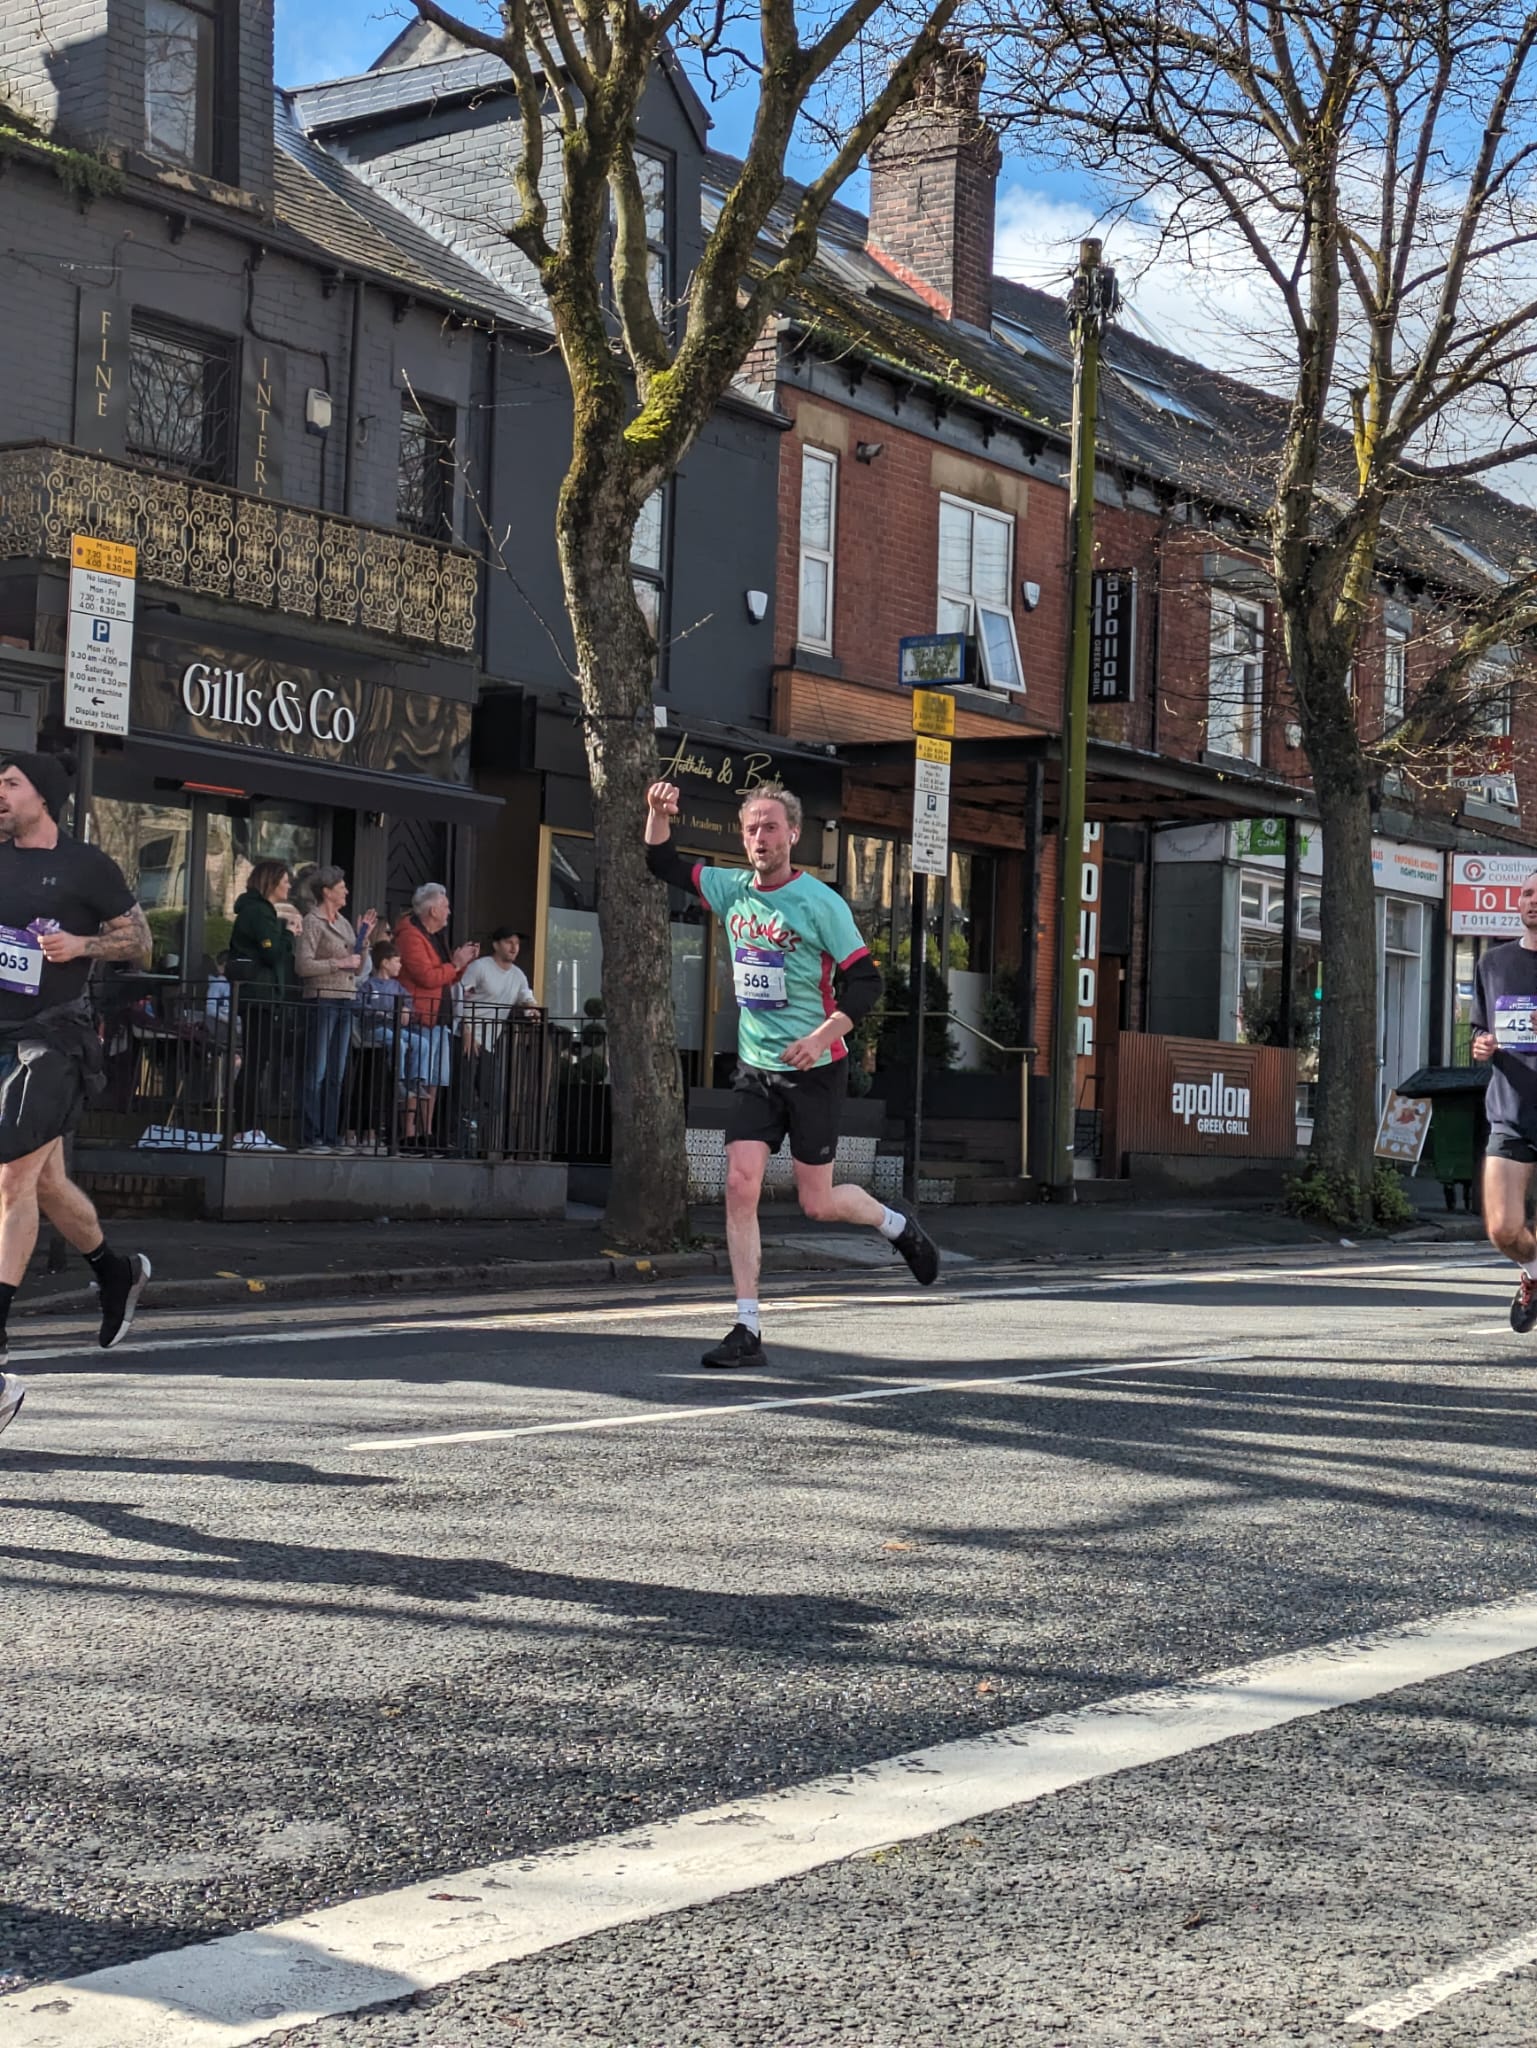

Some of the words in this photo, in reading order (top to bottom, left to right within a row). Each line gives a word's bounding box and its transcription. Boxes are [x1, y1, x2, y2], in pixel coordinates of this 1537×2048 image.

[95, 310, 113, 417] FINE
[96, 542, 111, 552] Mon
[115, 546, 125, 555] Fri
[123, 558, 133, 566] am
[122, 566, 133, 575] pm
[86, 573, 96, 582] No
[97, 575, 122, 588] loading
[89, 585, 104, 594] Mon
[108, 588, 118, 596] Fri
[115, 608, 126, 617] pm
[116, 601, 127, 609] am
[95, 621, 108, 640] P
[1102, 575, 1119, 696] apollon
[86, 643, 101, 653] Mon
[105, 647, 115, 655] Fri
[1093, 639, 1101, 669] GREEK
[87, 654, 98, 662] am
[84, 663, 114, 677] Saturday
[87, 674, 97, 682] am
[1092, 670, 1101, 696] GRILL
[73, 683, 86, 693] Pay
[87, 685, 95, 693] at
[95, 688, 123, 698] machine
[182, 662, 263, 727] Gills
[268, 680, 303, 734] &
[309, 688, 355, 743] Co
[75, 706, 99, 718] Display
[100, 710, 120, 721] ticket
[69, 716, 83, 725] Max
[84, 719, 99, 729] stay
[99, 721, 105, 729] 2
[106, 722, 125, 732] hours
[659, 732, 713, 780] Aesthetics
[716, 756, 734, 784] &
[927, 796, 937, 810] P
[690, 815, 723, 835] Academy
[1469, 886, 1497, 910] To
[1505, 887, 1521, 911] L
[1461, 914, 1468, 925] T
[1471, 914, 1497, 926] 0114
[1501, 916, 1521, 927] 272
[1076, 822, 1100, 1056] pollon
[743, 972, 770, 989] 568
[1172, 1072, 1250, 1125] apollon
[1197, 1118, 1225, 1134] GREEK
[1225, 1120, 1249, 1135] GRILL
